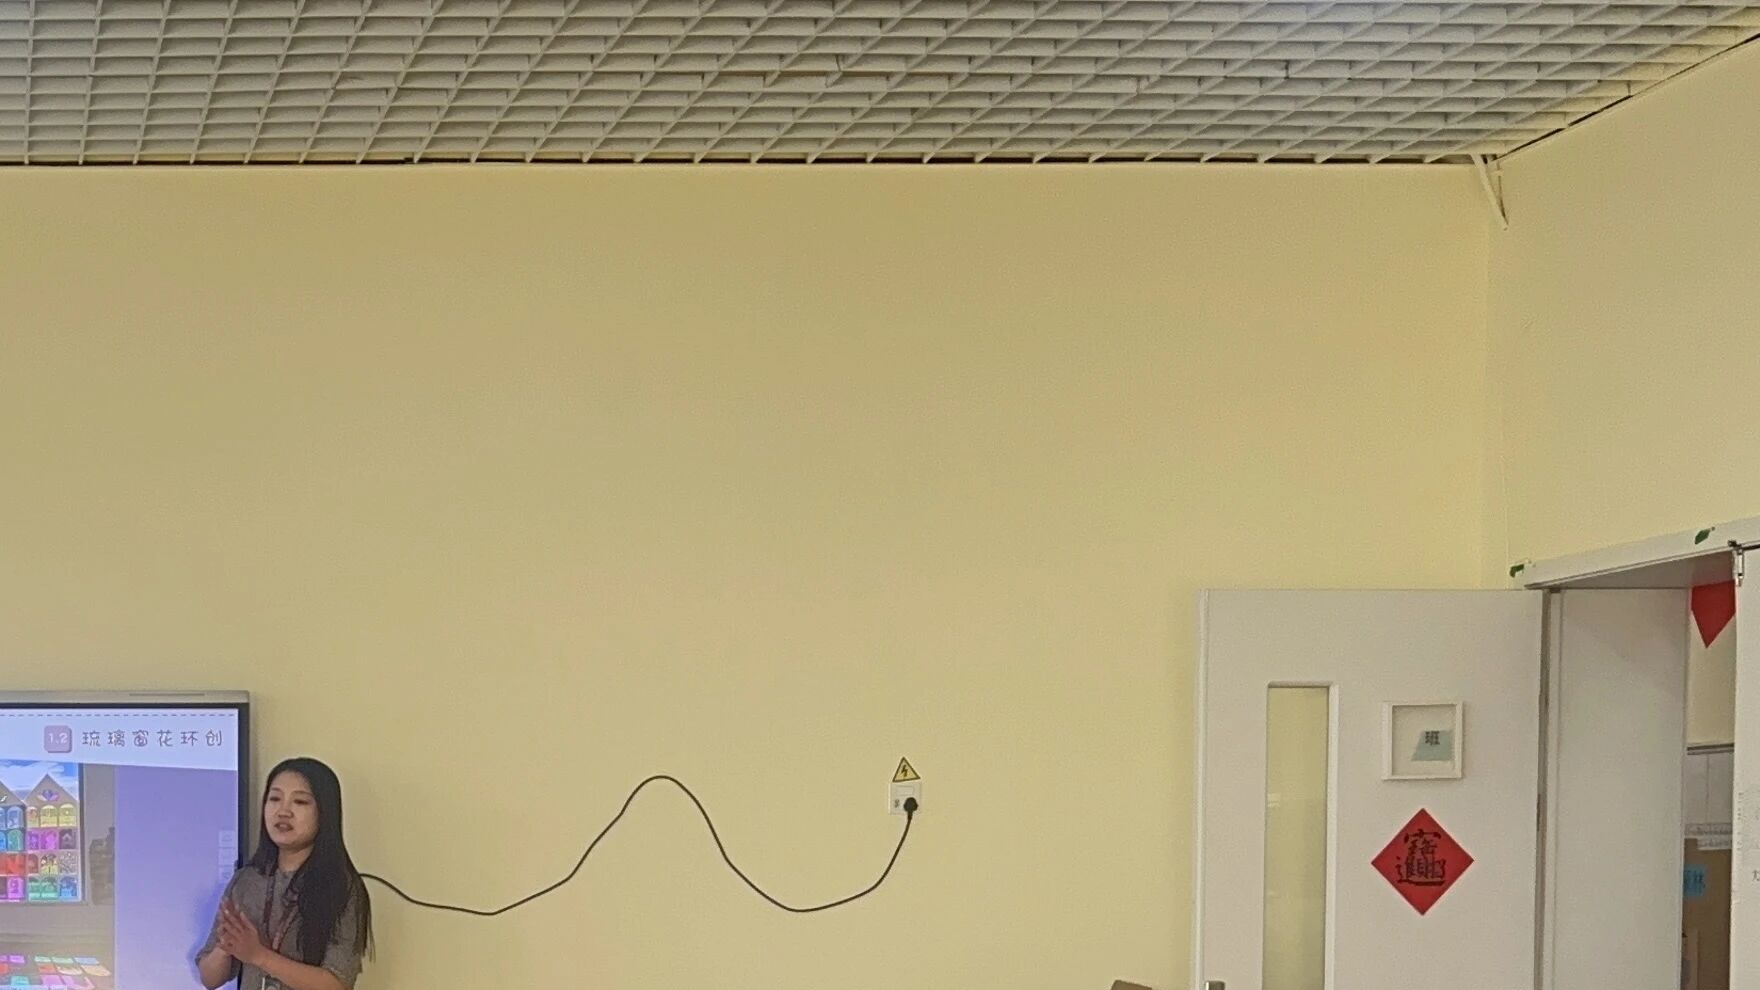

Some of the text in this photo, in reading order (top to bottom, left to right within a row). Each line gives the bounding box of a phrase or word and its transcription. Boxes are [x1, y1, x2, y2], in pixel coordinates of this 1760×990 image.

[47, 732, 69, 745] 1.2
[81, 730, 223, 747] 琉璃窗花环创
